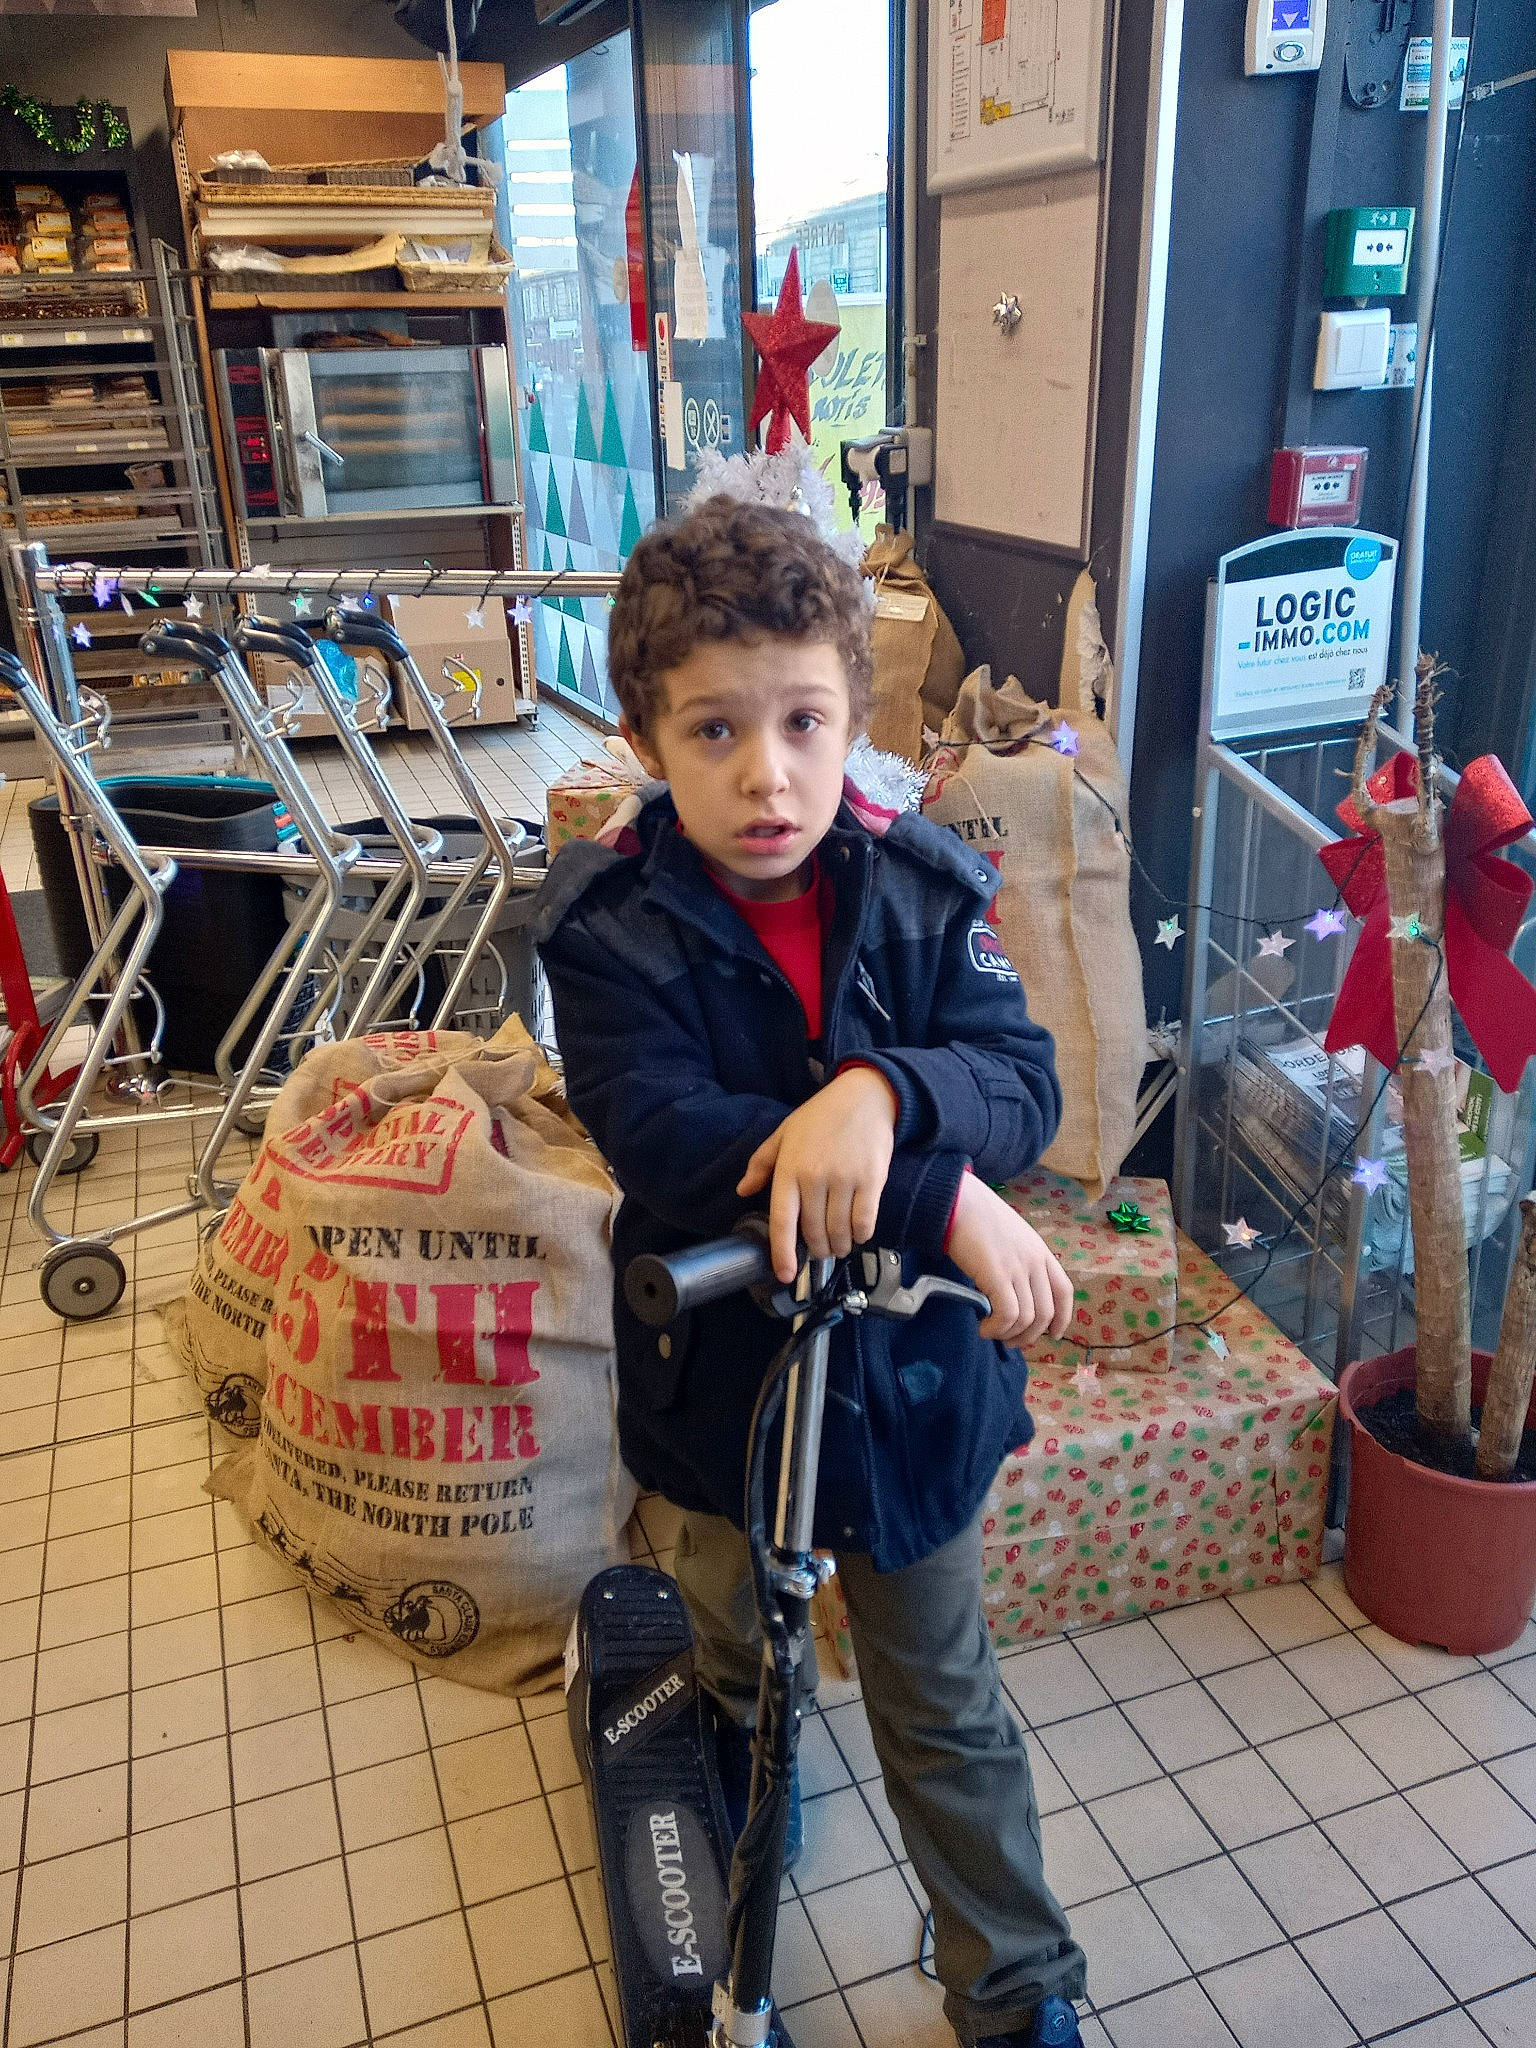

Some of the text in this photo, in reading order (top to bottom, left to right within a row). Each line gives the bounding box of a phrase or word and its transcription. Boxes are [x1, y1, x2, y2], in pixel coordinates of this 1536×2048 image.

[1256, 586, 1356, 628] LOGIC
[420, 1229, 546, 1261] UNTIL
[211, 1295, 267, 1340] NORTH
[312, 1480, 357, 1517] THE
[363, 1500, 450, 1538] NORTH
[461, 1505, 534, 1538] POLE
[354, 1470, 429, 1501] PLEASE
[436, 1476, 532, 1503] RETURN
[604, 1672, 686, 1746] E-SCOOTER
[649, 1810, 704, 1977] E-SCOOTER
